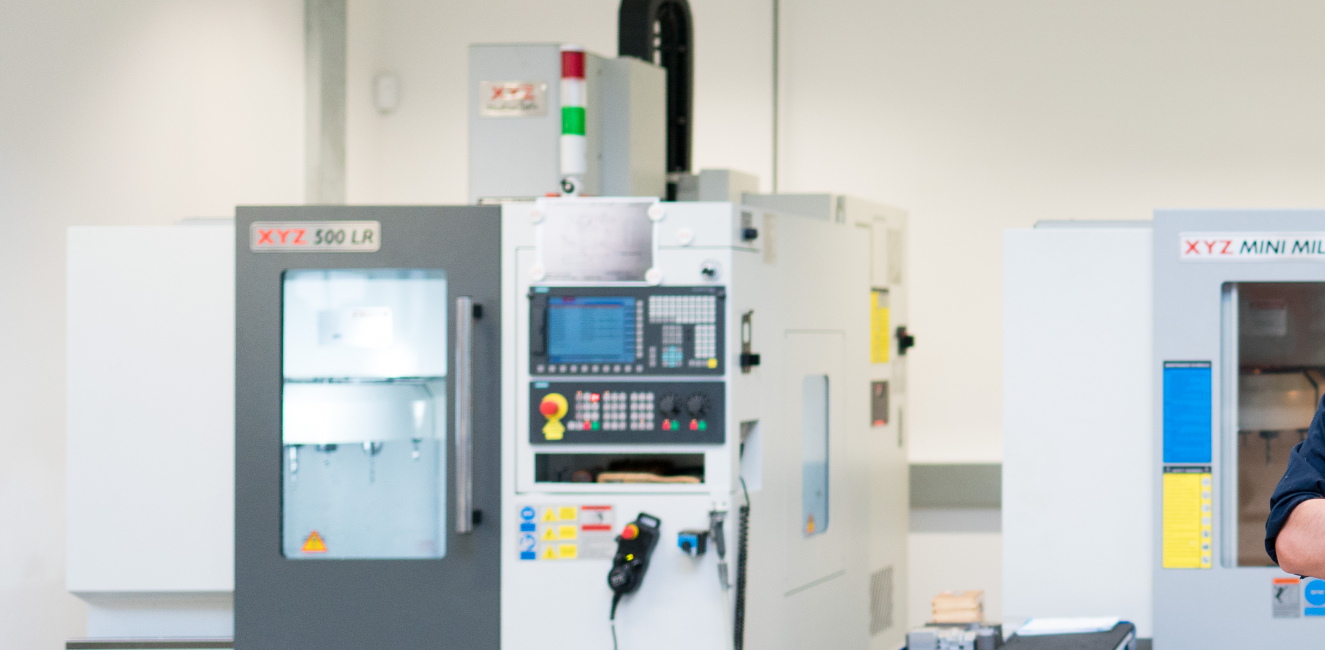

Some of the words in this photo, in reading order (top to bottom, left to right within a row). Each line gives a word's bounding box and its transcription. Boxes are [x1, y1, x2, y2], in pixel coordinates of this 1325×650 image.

[257, 228, 307, 246] XYZ
[314, 229, 345, 245] 500
[351, 229, 374, 245] LR
[1185, 239, 1234, 255] XYZ
[1239, 239, 1286, 255] MINI
